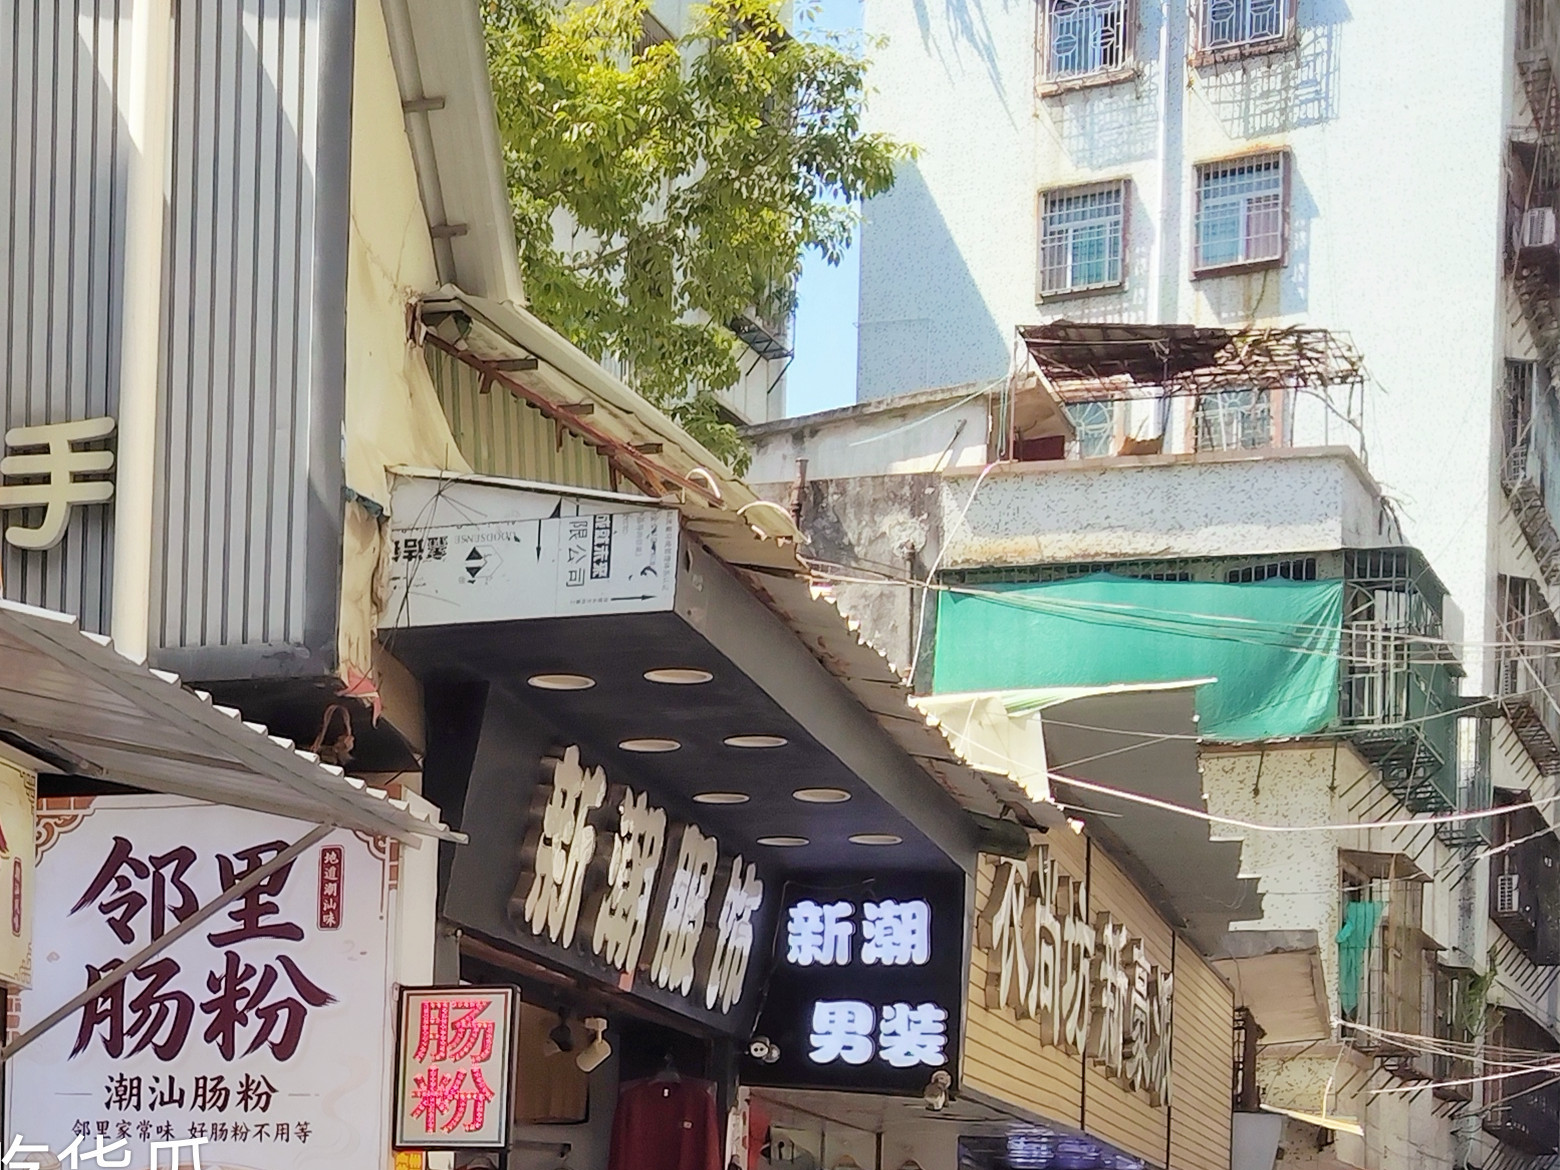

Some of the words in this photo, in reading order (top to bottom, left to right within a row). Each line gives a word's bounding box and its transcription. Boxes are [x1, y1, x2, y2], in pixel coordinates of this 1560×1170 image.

[566, 520, 588, 588] 限公司
[66, 836, 306, 949] 邻里
[322, 849, 341, 928] 地道潮汕味
[524, 744, 764, 1014] 新潮服饰
[786, 898, 933, 968] 新潮
[67, 949, 341, 1063] 肠粉
[807, 999, 950, 1068] 男装
[103, 1072, 280, 1115] 潮汕肠粉
[410, 999, 497, 1135] 肠粉
[71, 1117, 175, 1143] 邻里家常味
[187, 1116, 314, 1145] 好肠粉不用等
